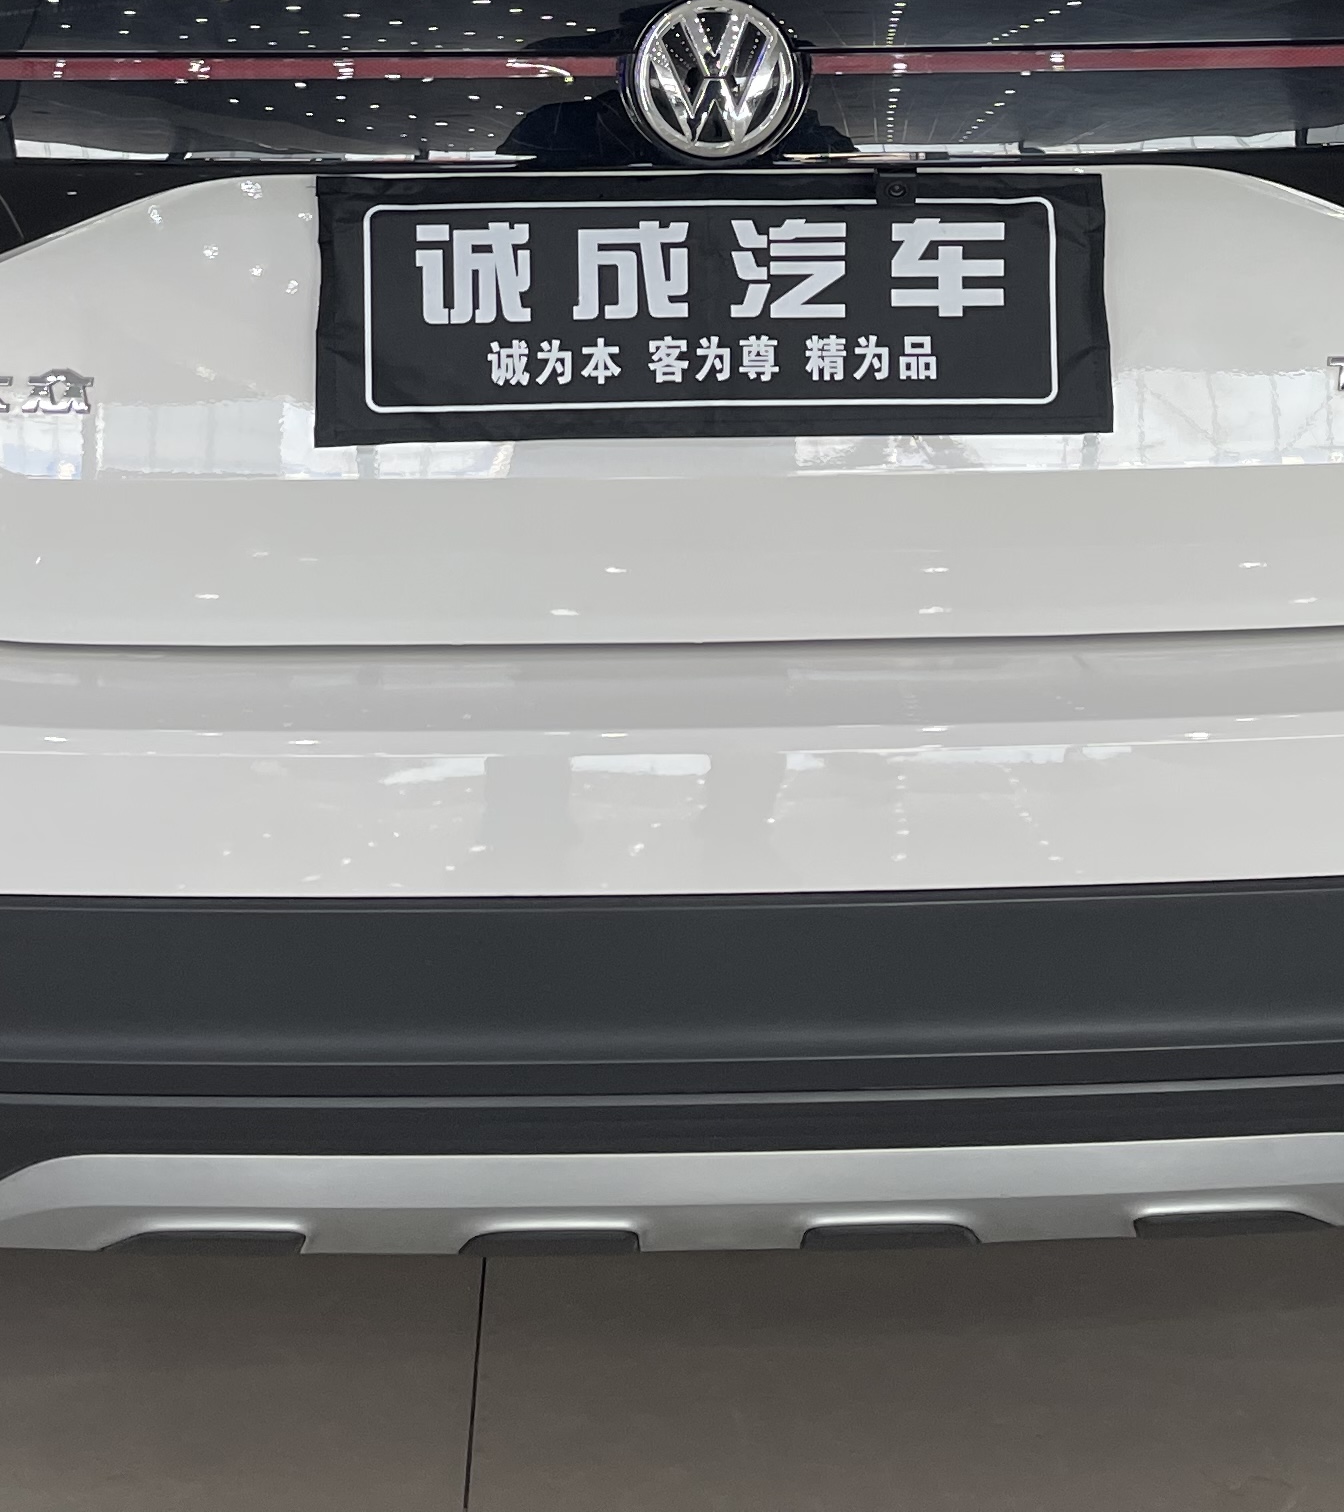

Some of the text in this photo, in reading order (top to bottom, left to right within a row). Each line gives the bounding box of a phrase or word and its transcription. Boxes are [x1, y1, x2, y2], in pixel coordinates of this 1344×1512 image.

[416, 218, 1005, 324] 诚成汽车
[488, 334, 939, 386] 诚为本 客为尊 精为品
